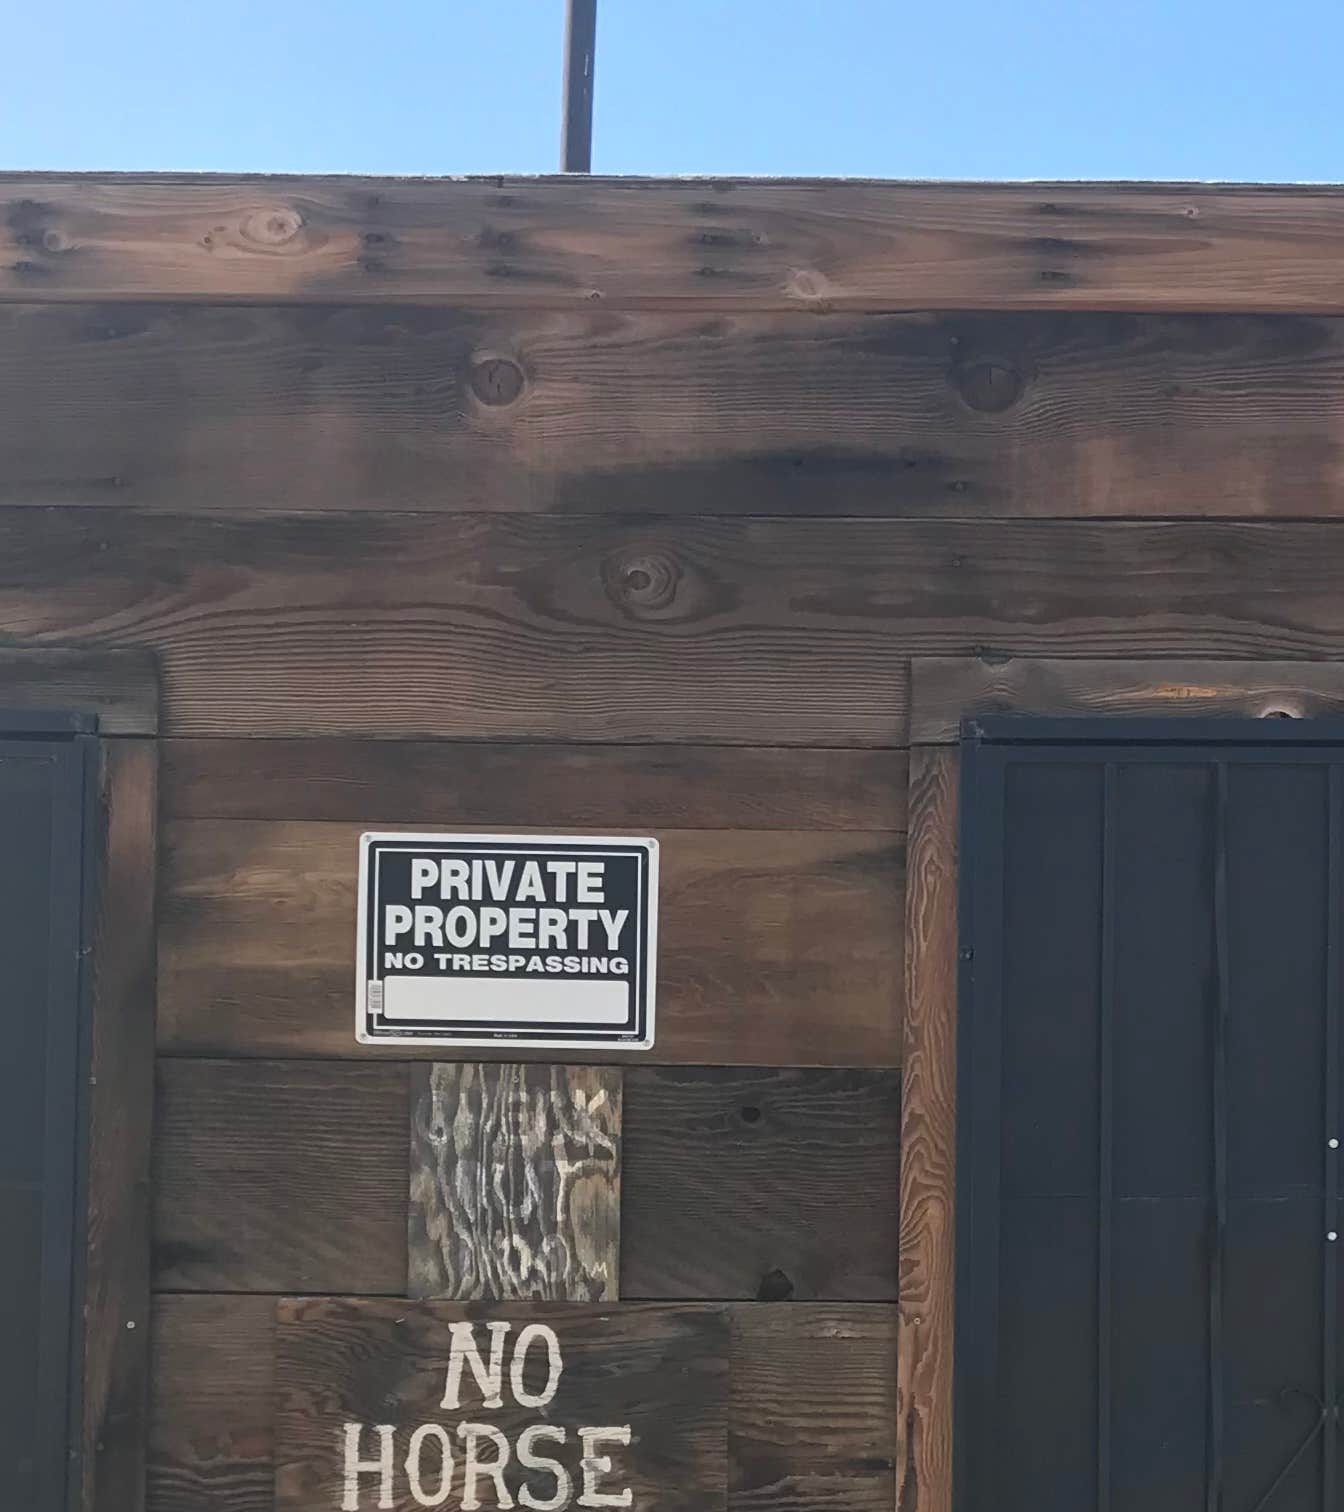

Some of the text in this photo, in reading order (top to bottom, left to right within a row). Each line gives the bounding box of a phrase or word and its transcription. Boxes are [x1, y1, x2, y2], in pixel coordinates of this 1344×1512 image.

[411, 858, 605, 904] PRIVATE
[384, 904, 630, 951] PROPERTY
[384, 952, 629, 974] NO TRESPASSING
[439, 1321, 563, 1409] NO
[341, 1421, 633, 1512] HORSE
